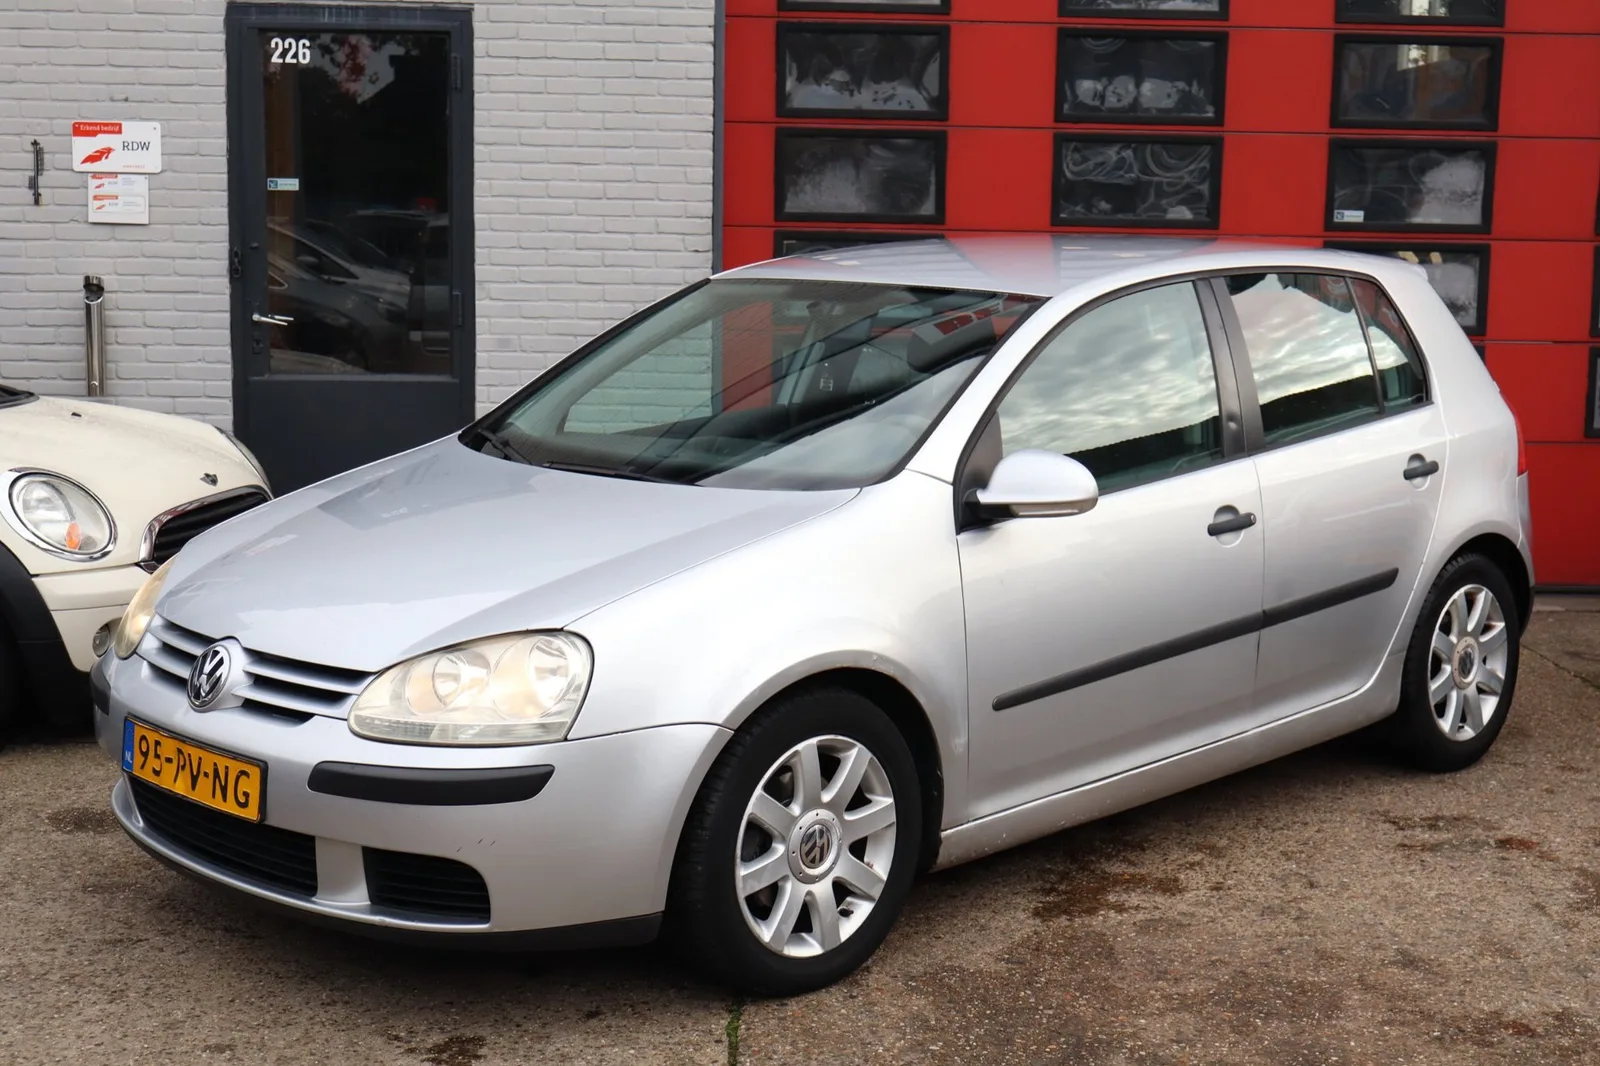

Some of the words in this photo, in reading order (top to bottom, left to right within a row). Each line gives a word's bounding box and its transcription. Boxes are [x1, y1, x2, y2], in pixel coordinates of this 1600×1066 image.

[270, 37, 311, 65] 226
[101, 124, 120, 132] bedrijf
[122, 141, 151, 152] RDW
[125, 750, 133, 764] NL
[138, 734, 251, 809] 95-PV-NG
